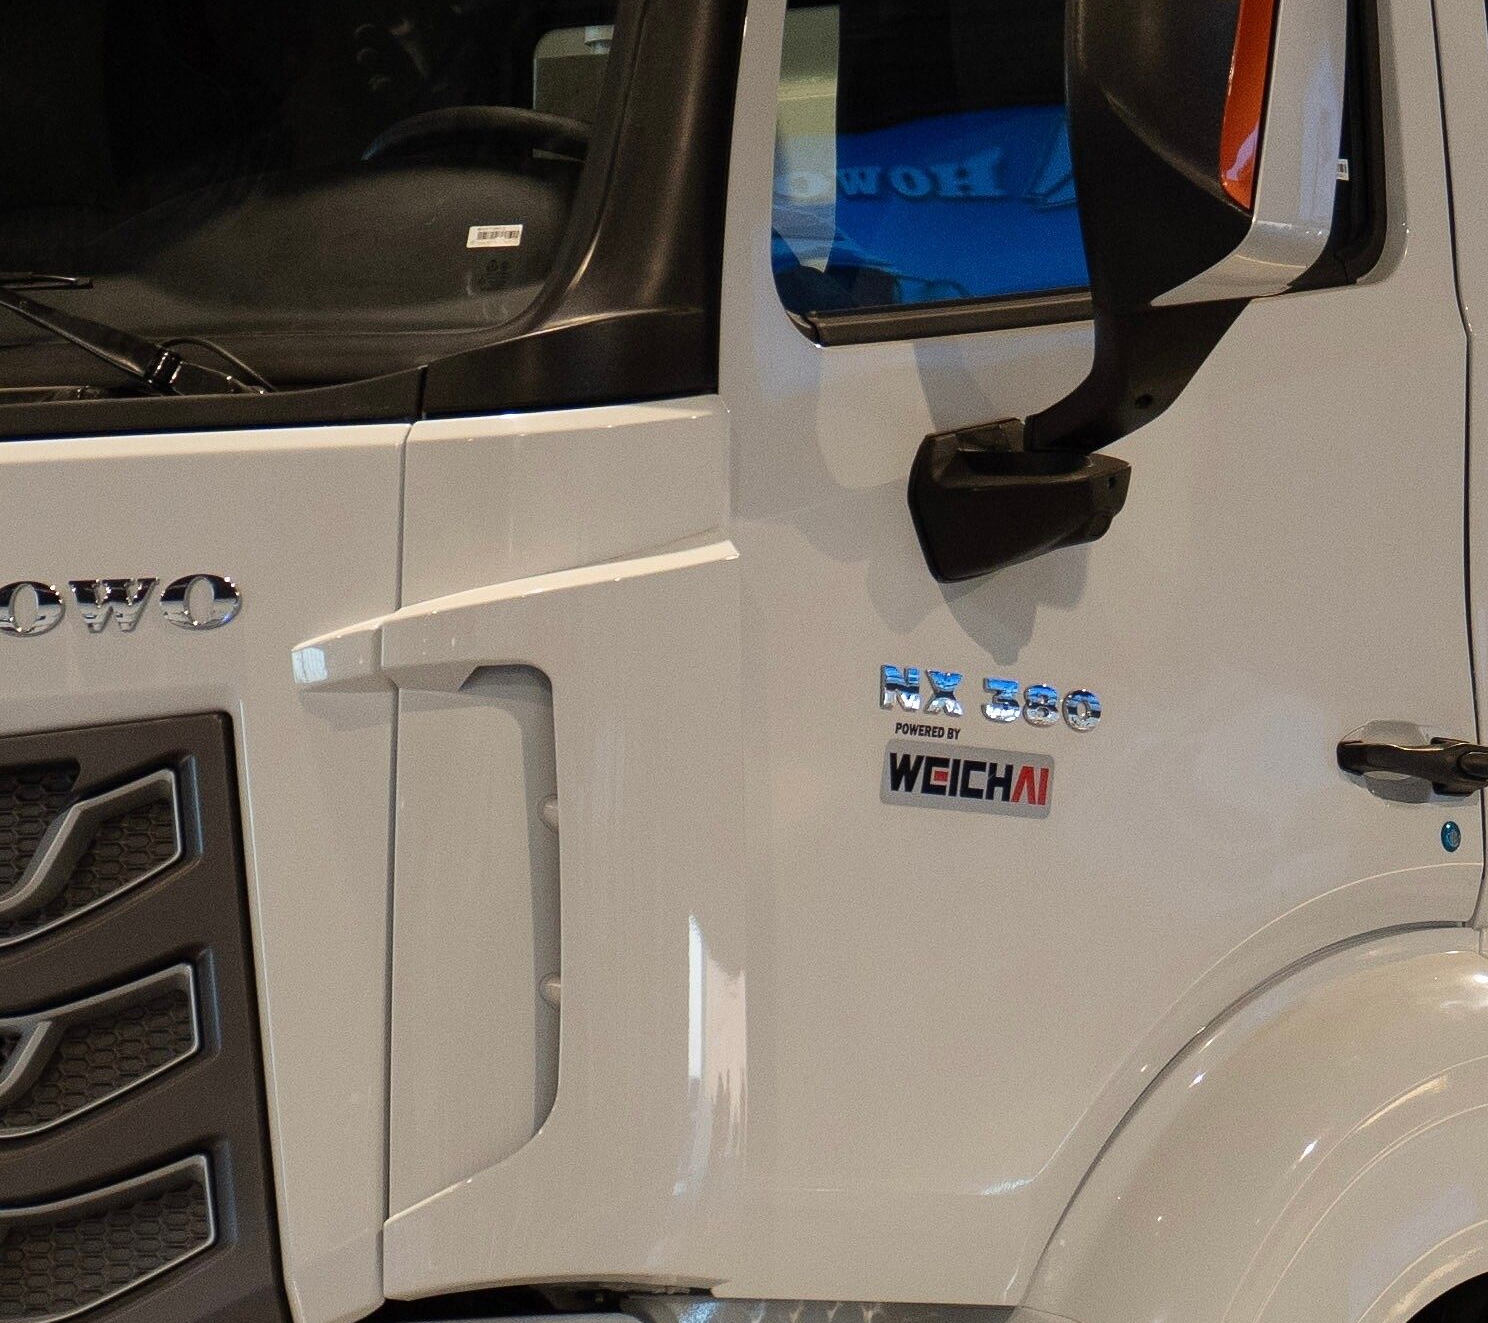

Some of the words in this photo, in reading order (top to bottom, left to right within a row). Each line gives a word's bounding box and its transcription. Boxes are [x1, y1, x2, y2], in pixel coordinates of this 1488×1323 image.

[879, 664, 964, 718] NX
[981, 676, 1103, 733] 380
[895, 722, 945, 739] POWERED
[946, 726, 961, 740] BY
[888, 752, 1051, 806] WEICHAI
